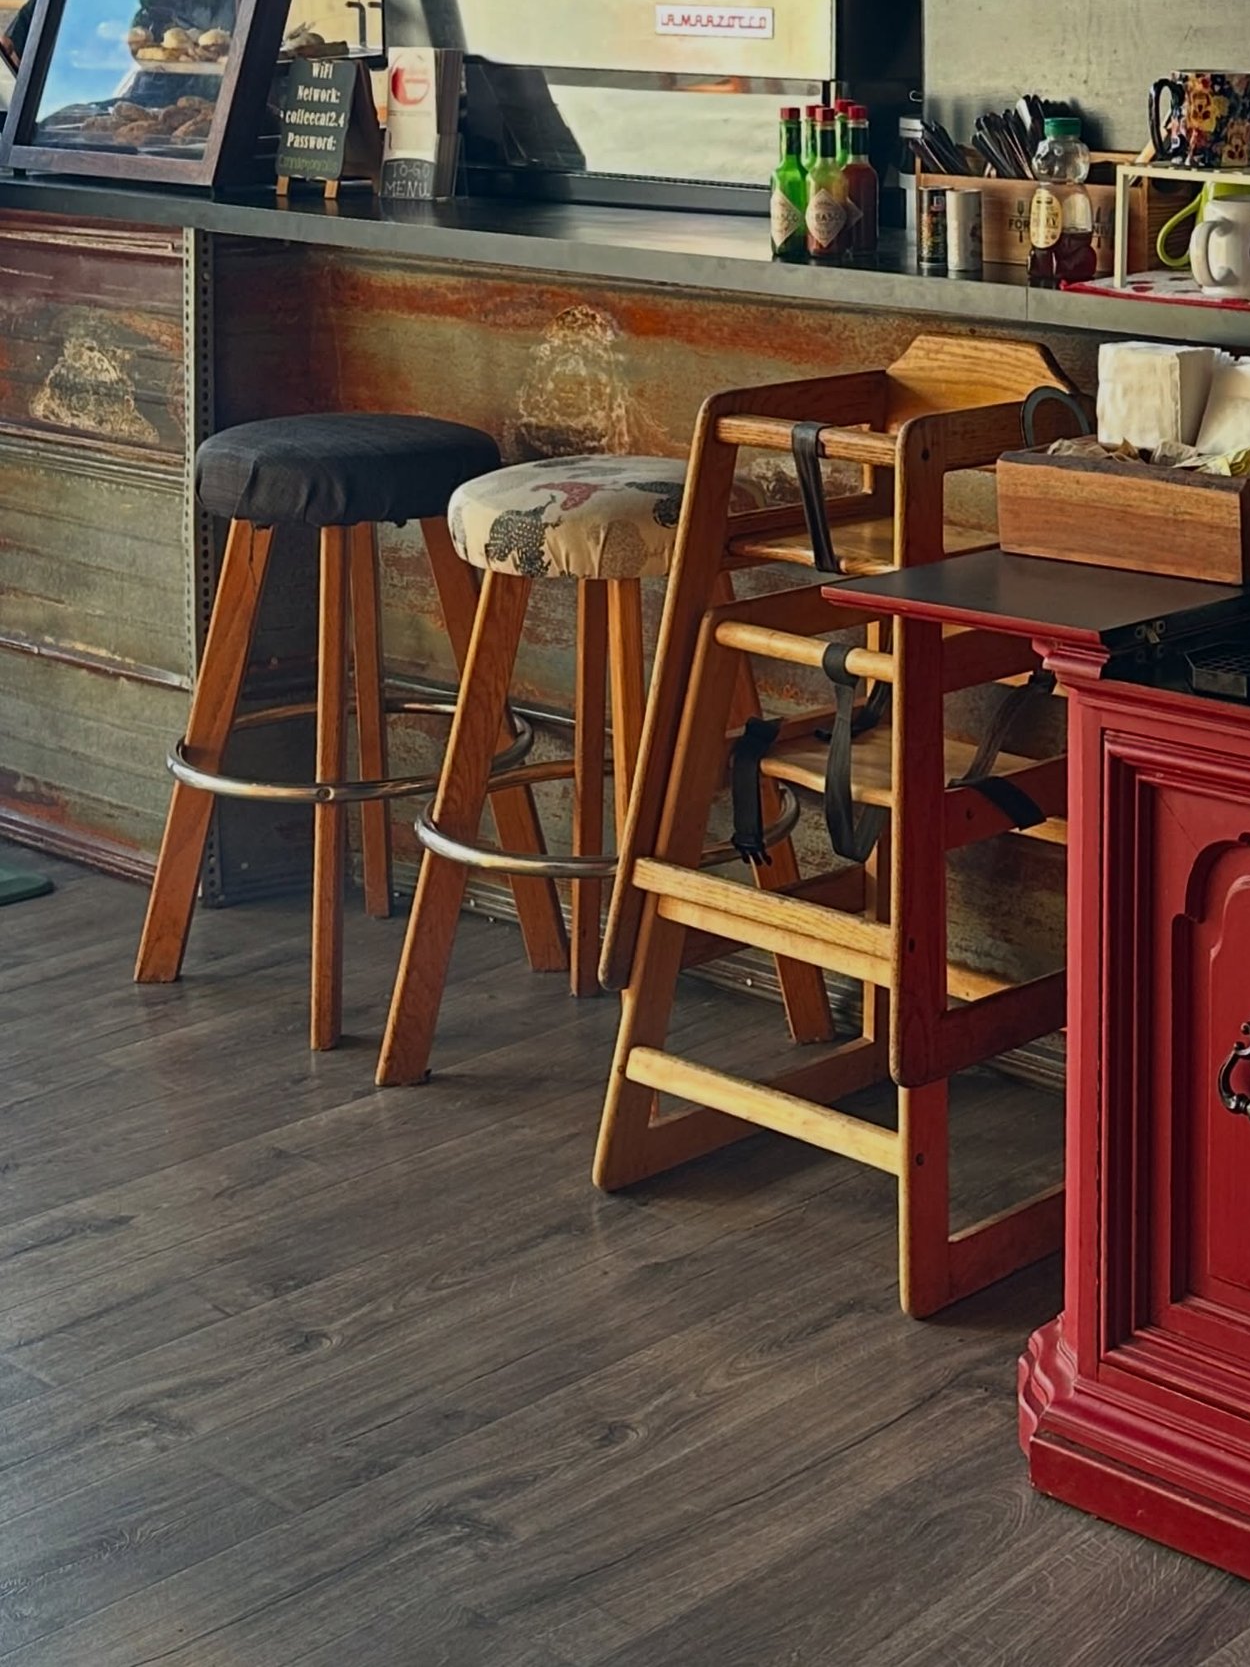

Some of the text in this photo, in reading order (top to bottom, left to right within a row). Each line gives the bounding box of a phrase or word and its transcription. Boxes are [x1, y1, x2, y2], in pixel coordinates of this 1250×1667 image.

[297, 85, 341, 104] Network:
[286, 132, 337, 152] Password:
[385, 180, 430, 198] MENU
